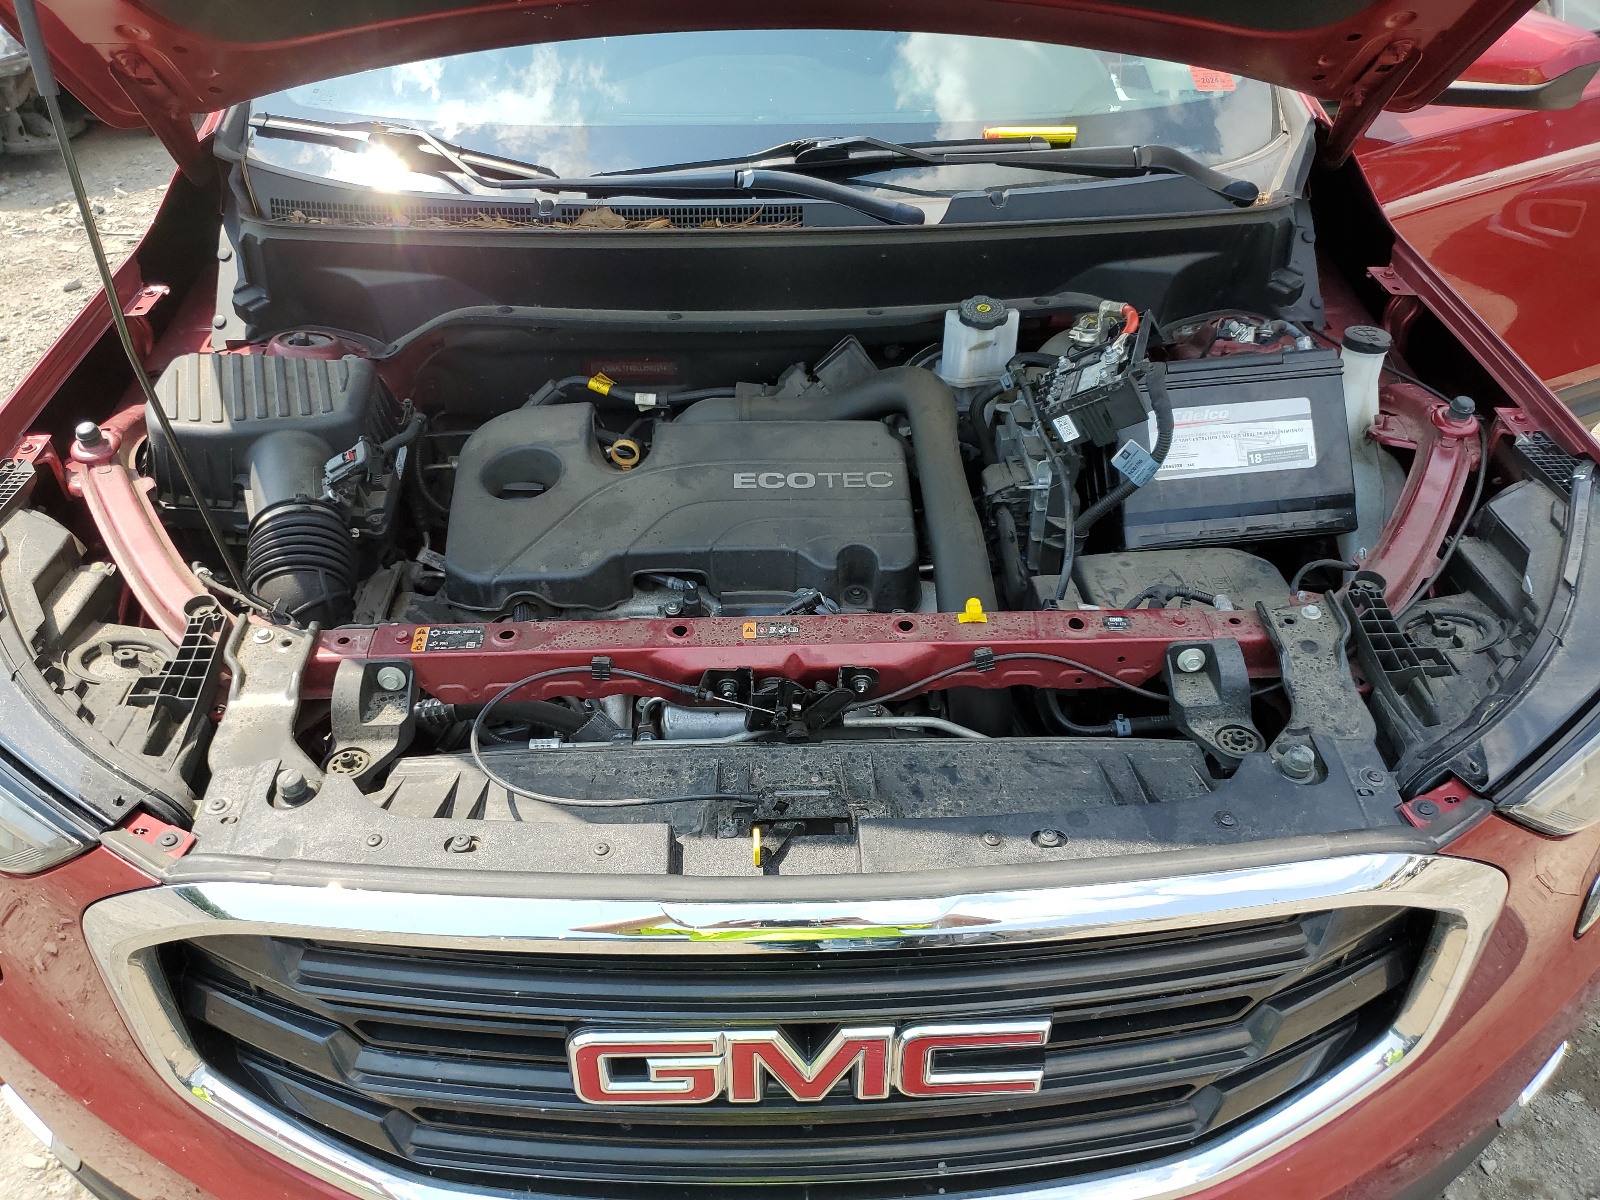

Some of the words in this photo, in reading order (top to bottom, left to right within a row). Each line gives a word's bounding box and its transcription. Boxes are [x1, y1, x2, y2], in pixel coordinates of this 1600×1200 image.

[1173, 408, 1230, 421] CDelco
[1248, 453, 1263, 464] 18
[733, 471, 894, 489] ECOTEC
[566, 1019, 1053, 1105] GMC
